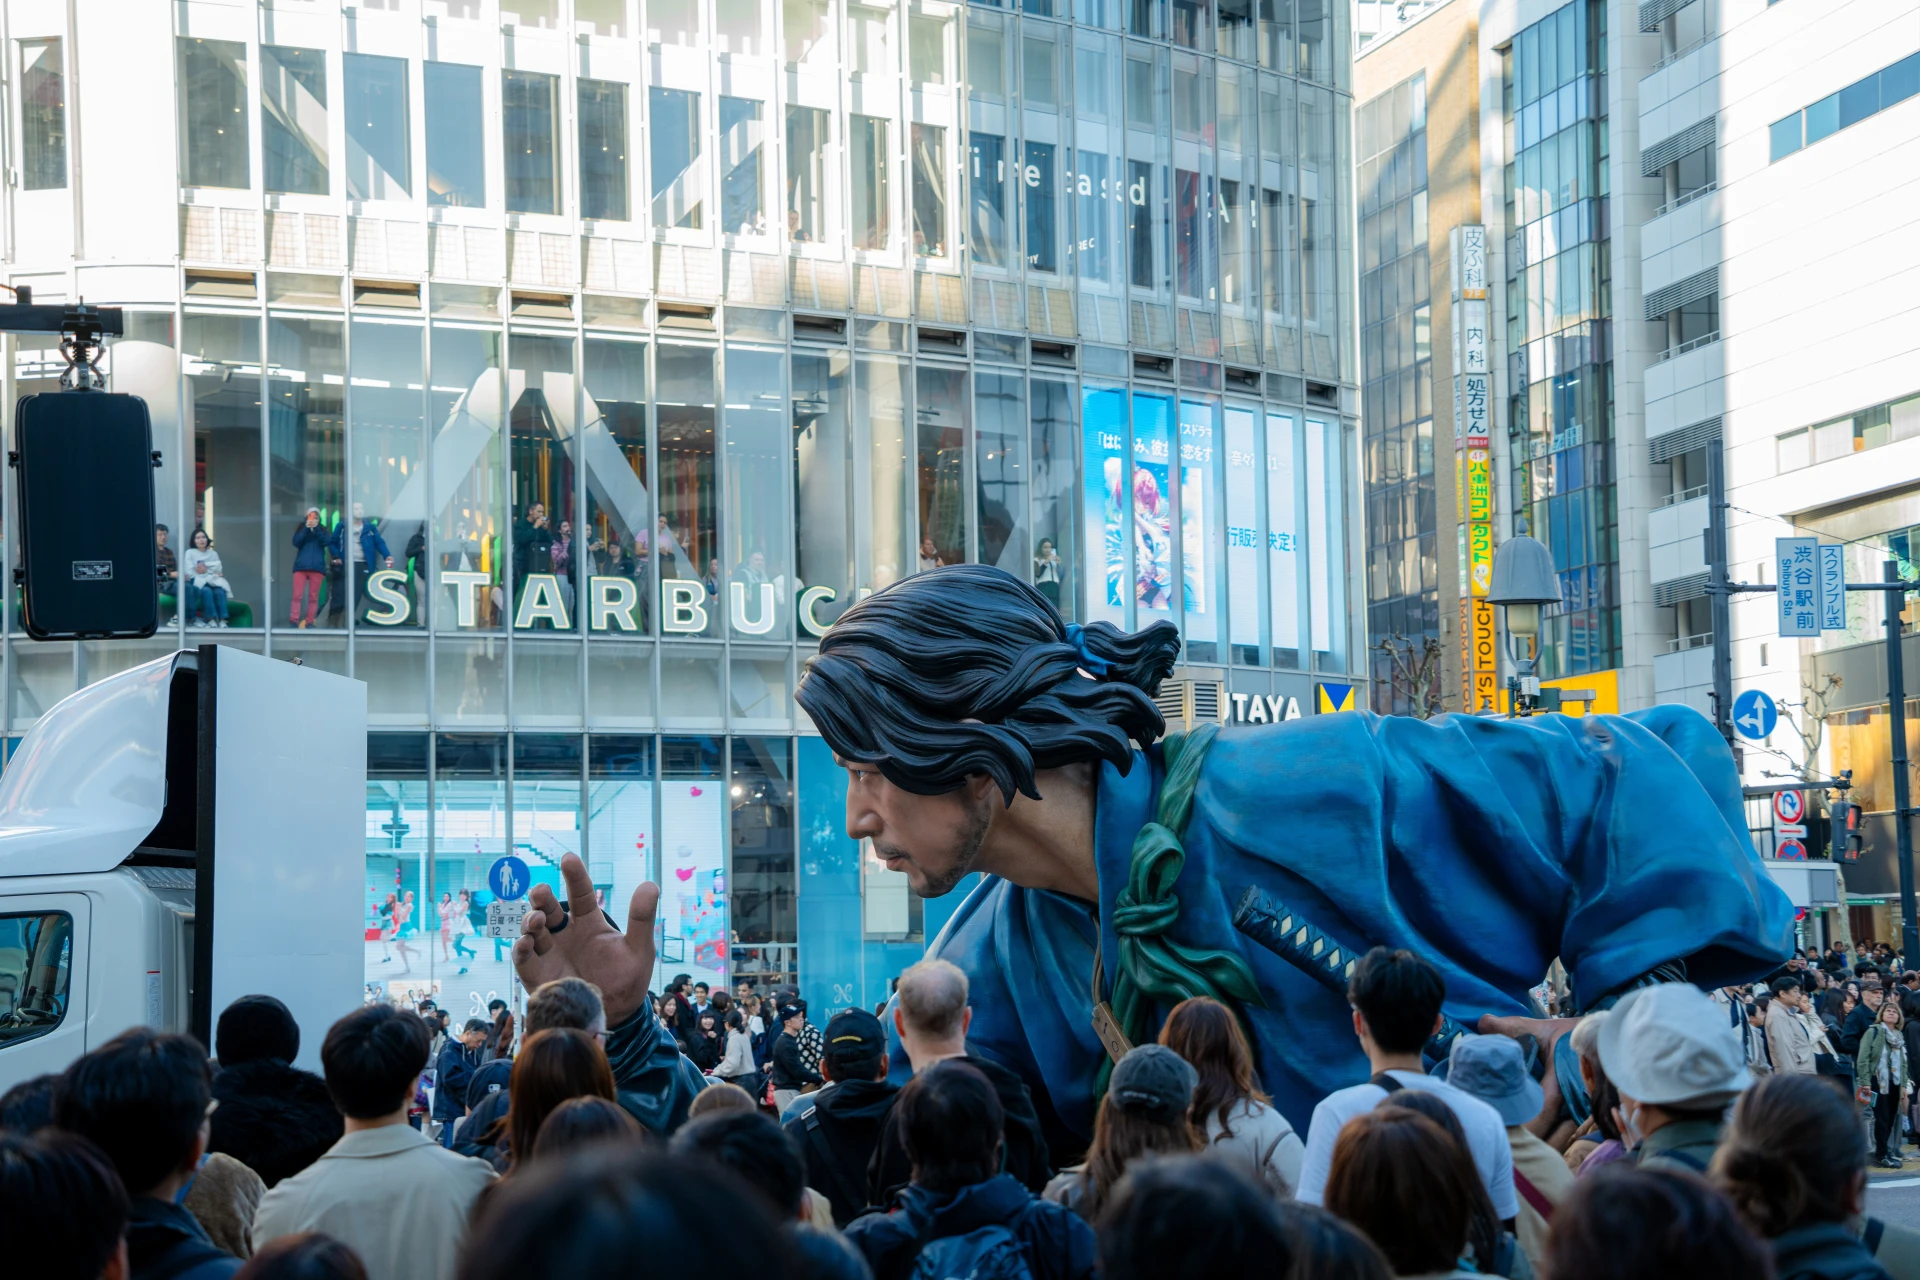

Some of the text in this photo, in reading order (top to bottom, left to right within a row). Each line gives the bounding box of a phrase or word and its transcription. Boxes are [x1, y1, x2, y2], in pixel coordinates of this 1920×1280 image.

[1464, 229, 1482, 287] 皮ふ科
[1467, 289, 1482, 299] 7F
[1467, 327, 1484, 367] 内科
[1467, 379, 1486, 433] 処方せん
[1472, 451, 1485, 461] 4F
[1781, 558, 1793, 619] Shibuya Sta.
[1794, 545, 1814, 629] 渋谷駅前
[1824, 548, 1840, 627] スクランブル式
[1477, 598, 1492, 669] TOUCH
[492, 905, 501, 914] 15
[492, 926, 501, 936] 12
